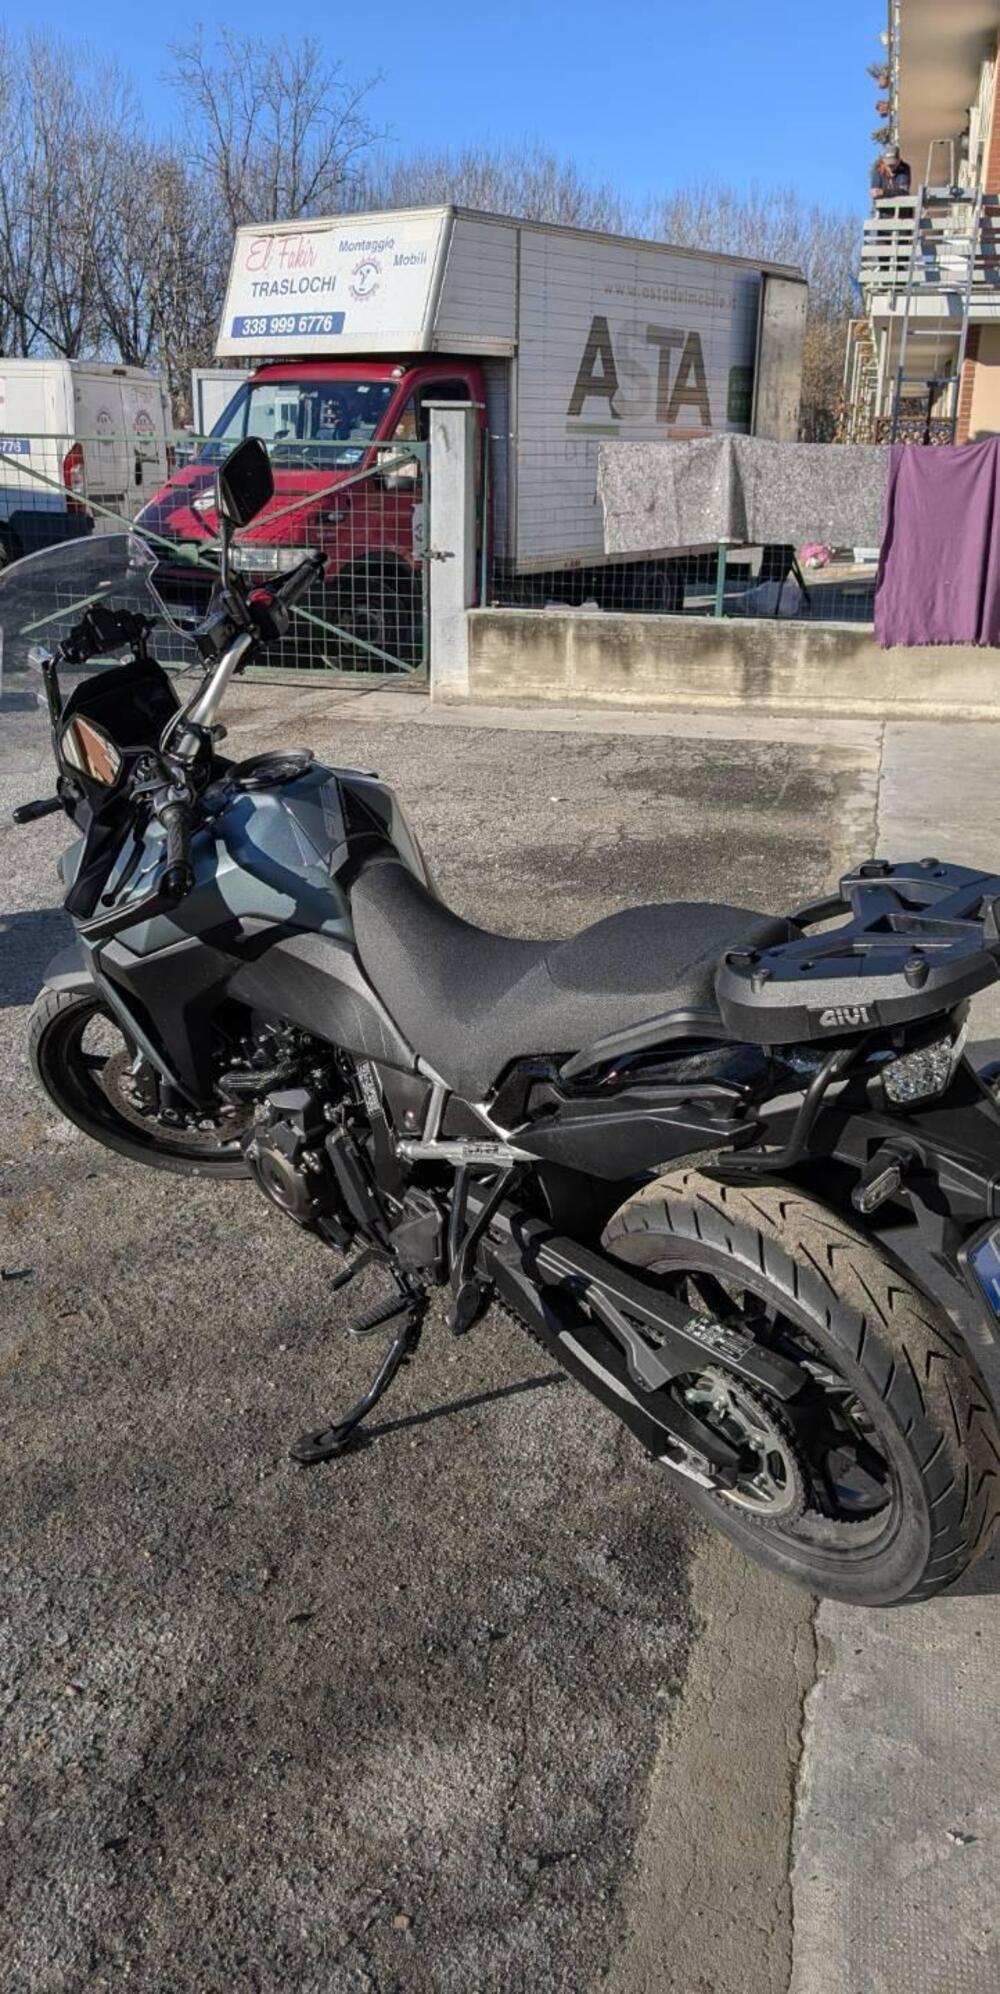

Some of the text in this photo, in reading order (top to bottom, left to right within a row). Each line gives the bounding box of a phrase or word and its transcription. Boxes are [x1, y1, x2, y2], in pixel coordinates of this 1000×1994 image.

[339, 236, 395, 252] Montaggio
[246, 236, 317, 272] El Fakir
[393, 252, 427, 266] Mobili
[251, 276, 336, 297] TRASLOCHI
[242, 315, 333, 334] 338 999 6776
[566, 316, 712, 426] ASTA
[0, 441, 21, 452] 776
[819, 1007, 870, 1026] GIVI
